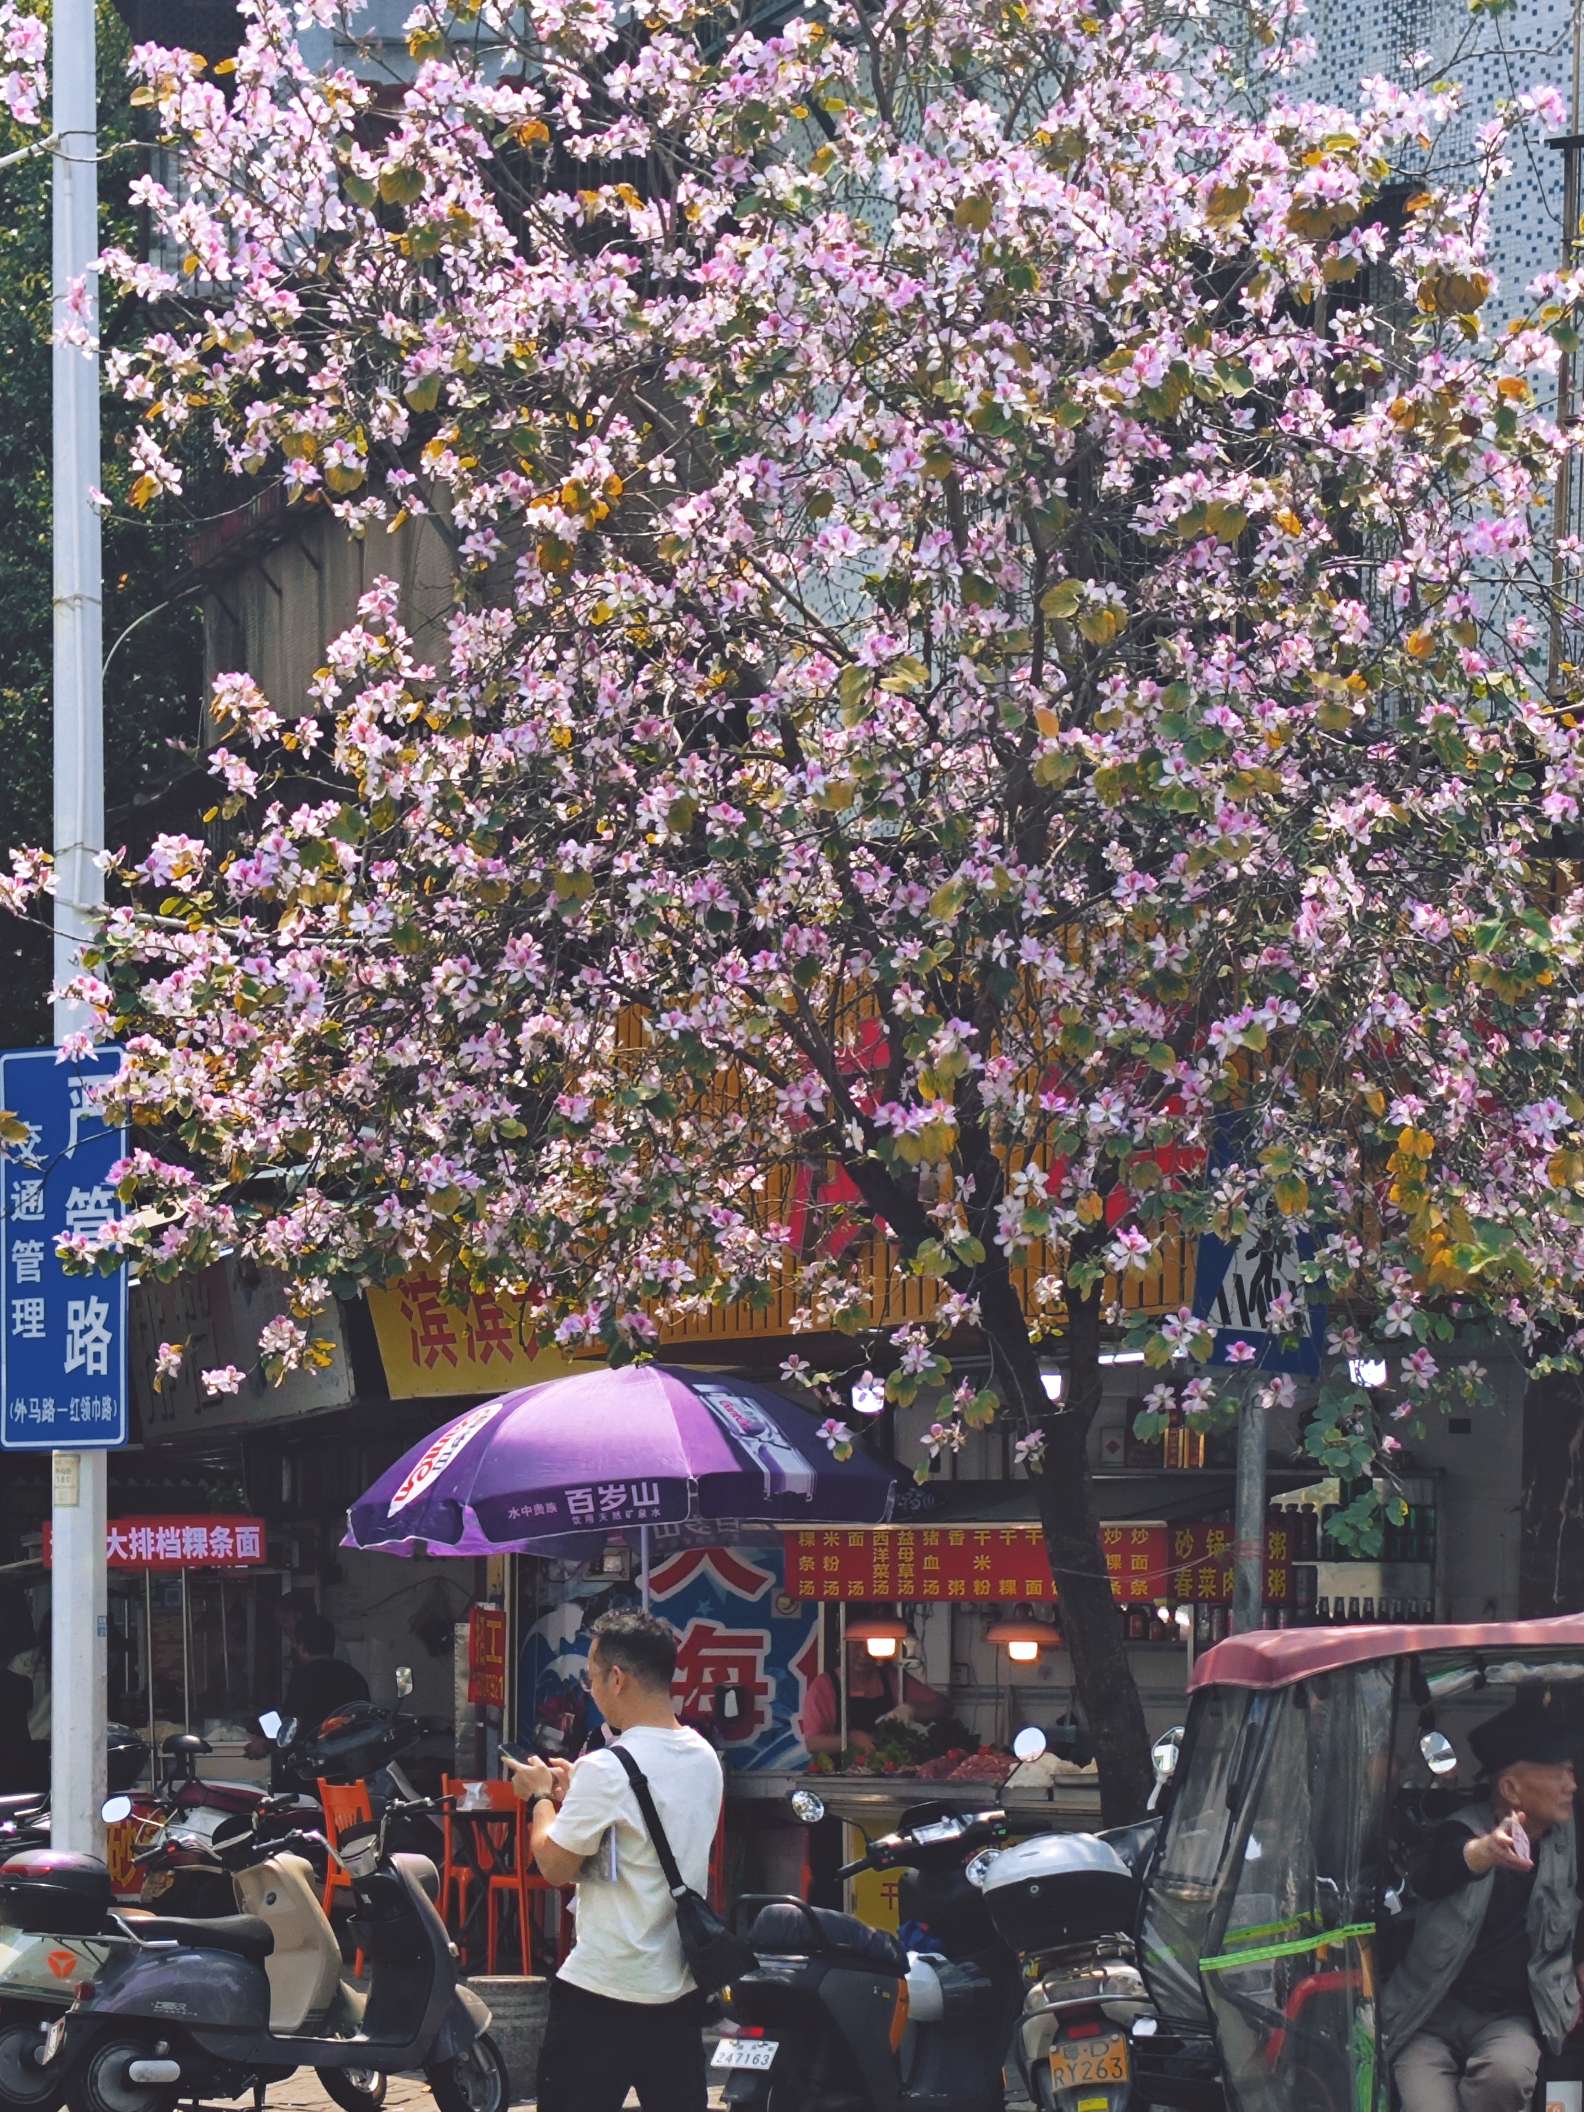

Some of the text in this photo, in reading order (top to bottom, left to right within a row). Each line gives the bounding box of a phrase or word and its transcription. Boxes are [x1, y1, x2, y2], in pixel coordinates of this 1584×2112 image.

[11, 1121, 47, 1339] 交通管理
[508, 1502, 558, 1520] 水中贵族
[564, 1481, 661, 1515] 百岁山
[51, 1525, 262, 1561] 大排档粿条面
[799, 1530, 817, 1597] 粿条汤
[822, 1530, 840, 1597] 米粉汤
[847, 1530, 865, 1597] 面汤
[872, 1530, 890, 1597] 西洋菜汤
[896, 1529, 915, 1597] 益母草汤
[922, 1529, 941, 1597] 猪血汤
[972, 1530, 992, 1597] 干米粉
[1024, 1529, 1044, 1597] 干面
[1129, 1528, 1150, 1596] 炒面条
[1173, 1529, 1288, 1561] 砂锅粥
[1173, 1567, 1288, 1599] 春菜肉粥
[1053, 2056, 1123, 2090] RY263
